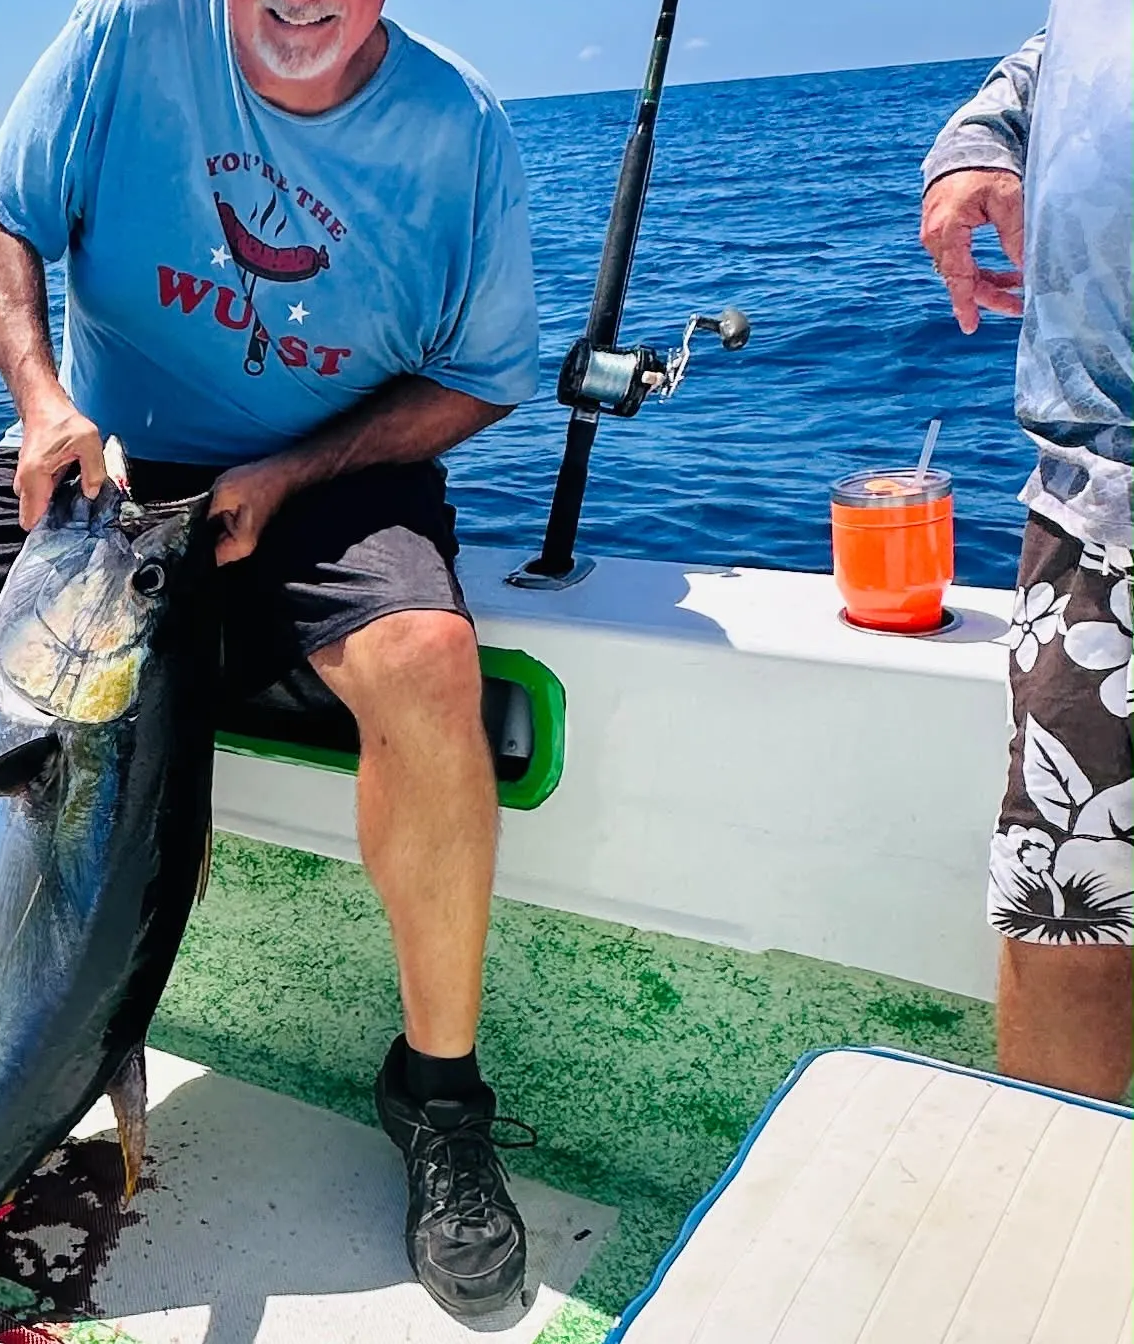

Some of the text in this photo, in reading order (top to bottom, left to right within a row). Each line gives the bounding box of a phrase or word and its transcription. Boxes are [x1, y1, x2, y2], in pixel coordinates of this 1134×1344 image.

[206, 152, 347, 242] YOU'RE THE
[158, 265, 352, 376] WUST
